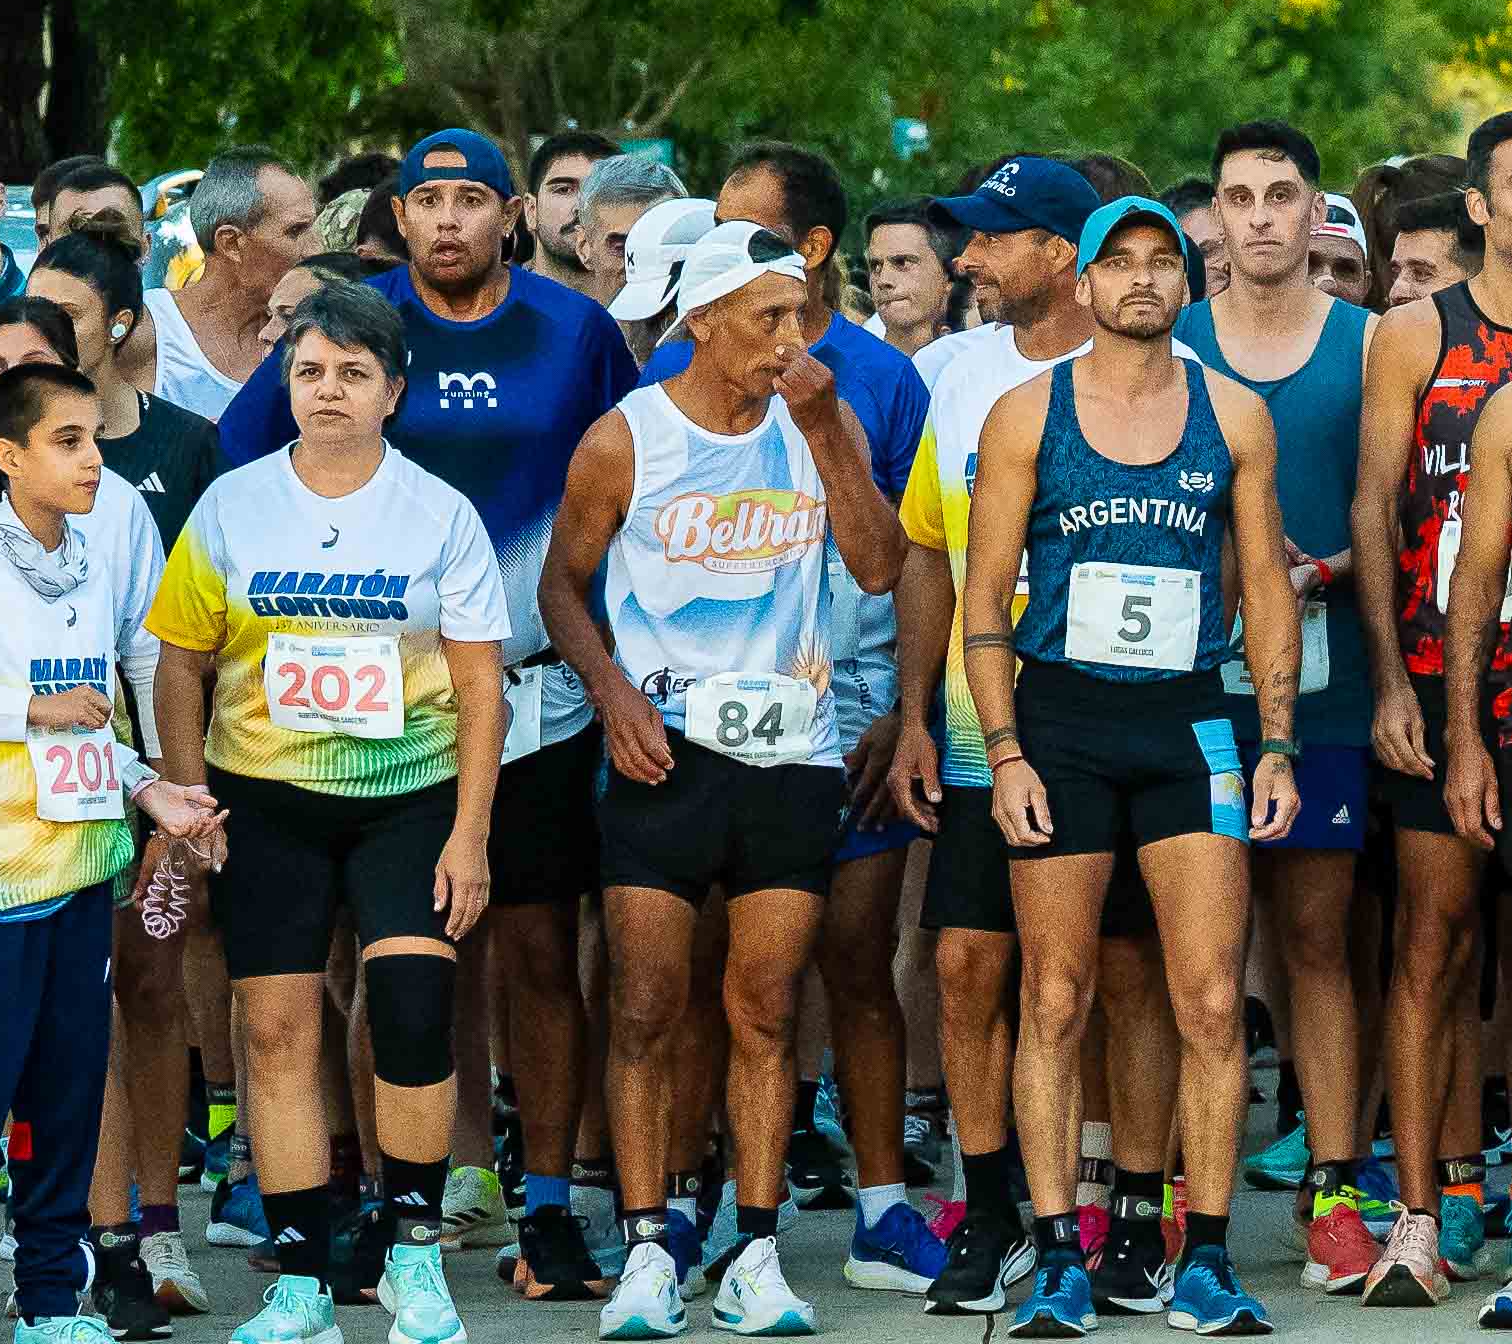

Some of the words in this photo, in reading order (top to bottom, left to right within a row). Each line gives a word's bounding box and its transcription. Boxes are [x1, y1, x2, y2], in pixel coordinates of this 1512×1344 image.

[1058, 497, 1207, 537] ARGENTINA
[248, 569, 410, 599] MARATÓN
[249, 596, 410, 621] ELORTONDO
[296, 619, 381, 633] ANIVERSARIO
[1117, 594, 1152, 643] 5
[277, 662, 389, 712] 202
[716, 700, 785, 747] 84
[45, 743, 120, 794] 201
